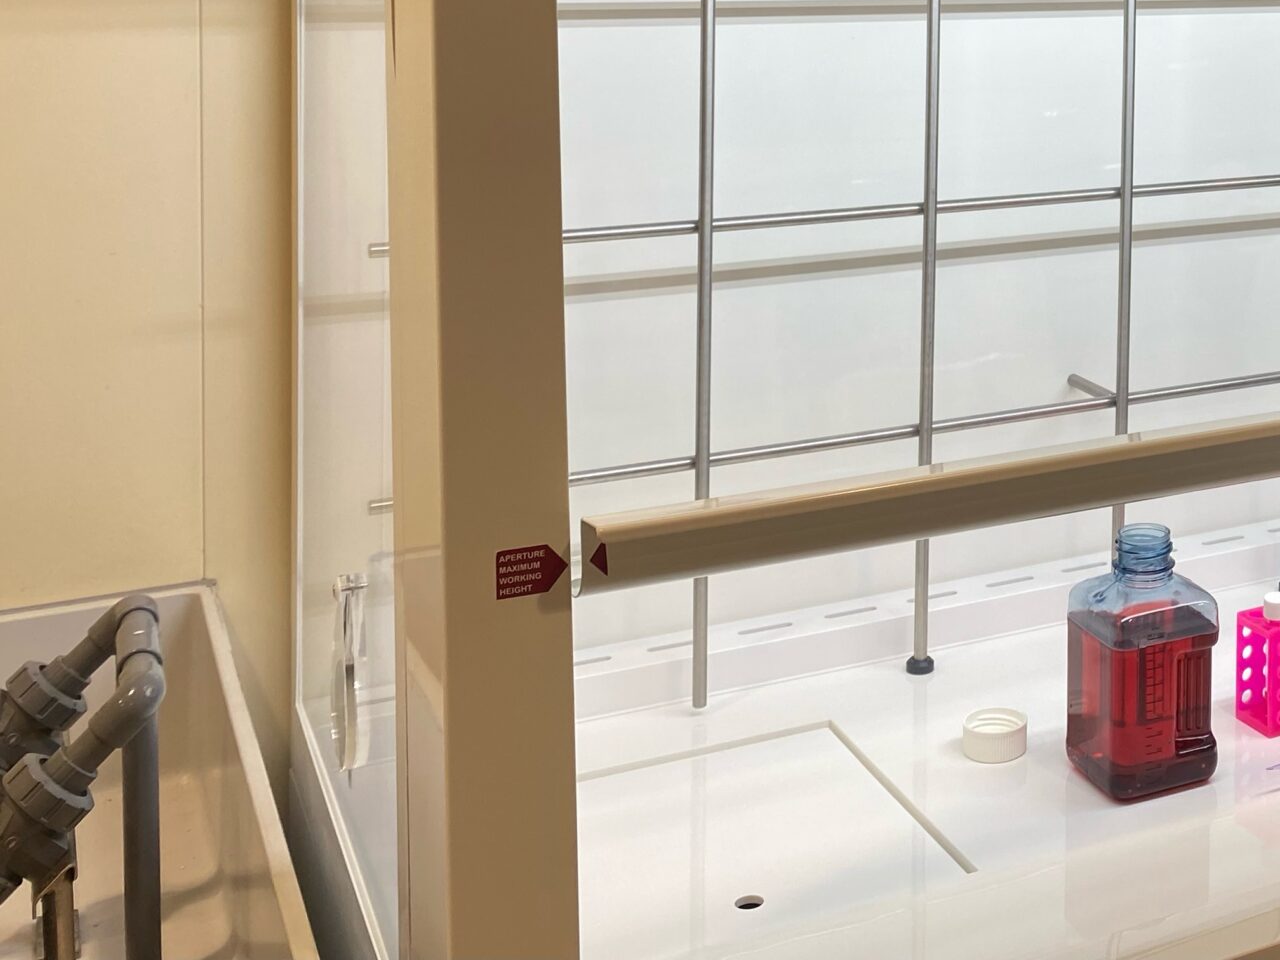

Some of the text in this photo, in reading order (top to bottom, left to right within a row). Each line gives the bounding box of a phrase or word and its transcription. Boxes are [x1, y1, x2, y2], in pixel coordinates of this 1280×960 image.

[499, 550, 545, 563] APERTURE
[499, 561, 540, 573] MAXIMUM
[499, 572, 542, 584] WORKING
[499, 584, 532, 596] HEIGHT
